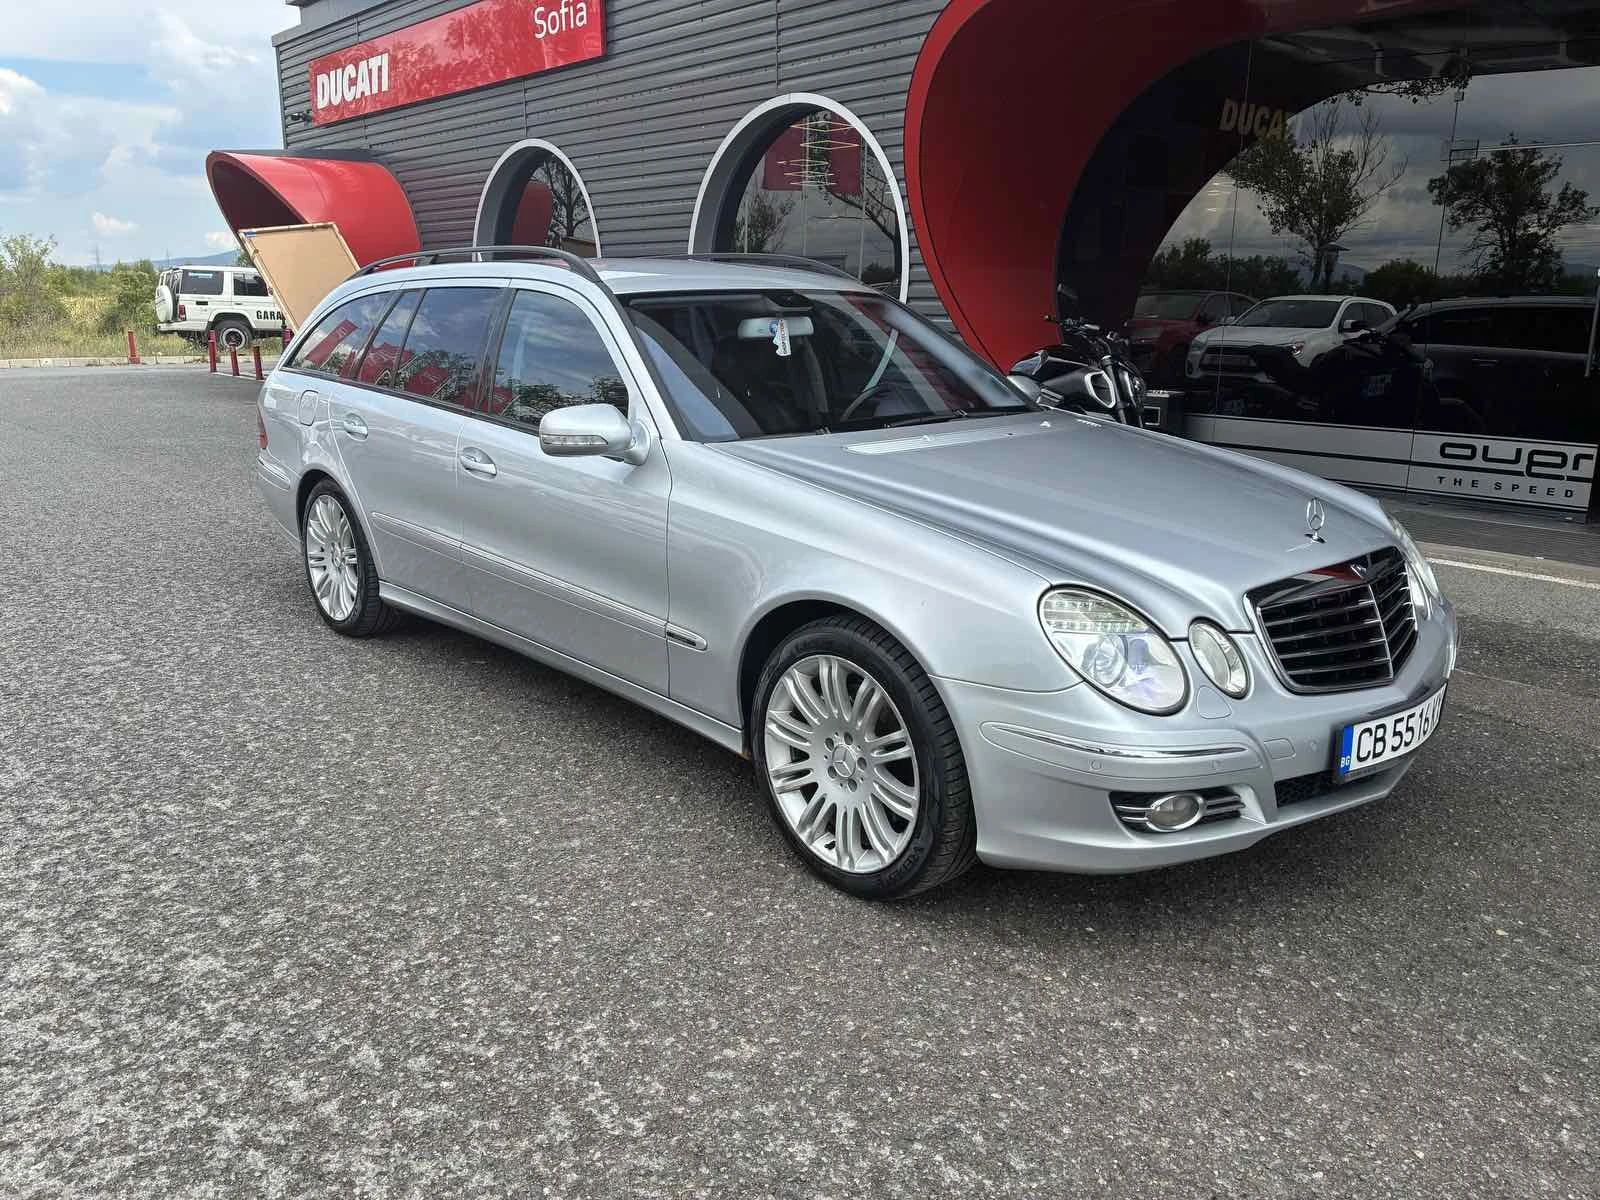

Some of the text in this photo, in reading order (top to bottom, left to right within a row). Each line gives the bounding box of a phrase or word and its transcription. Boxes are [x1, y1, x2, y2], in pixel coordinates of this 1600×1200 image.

[534, 0, 587, 39] Sofia
[316, 52, 389, 110] DUCATI
[1437, 475, 1575, 499] THE SPEED
[1340, 755, 1351, 768] BG
